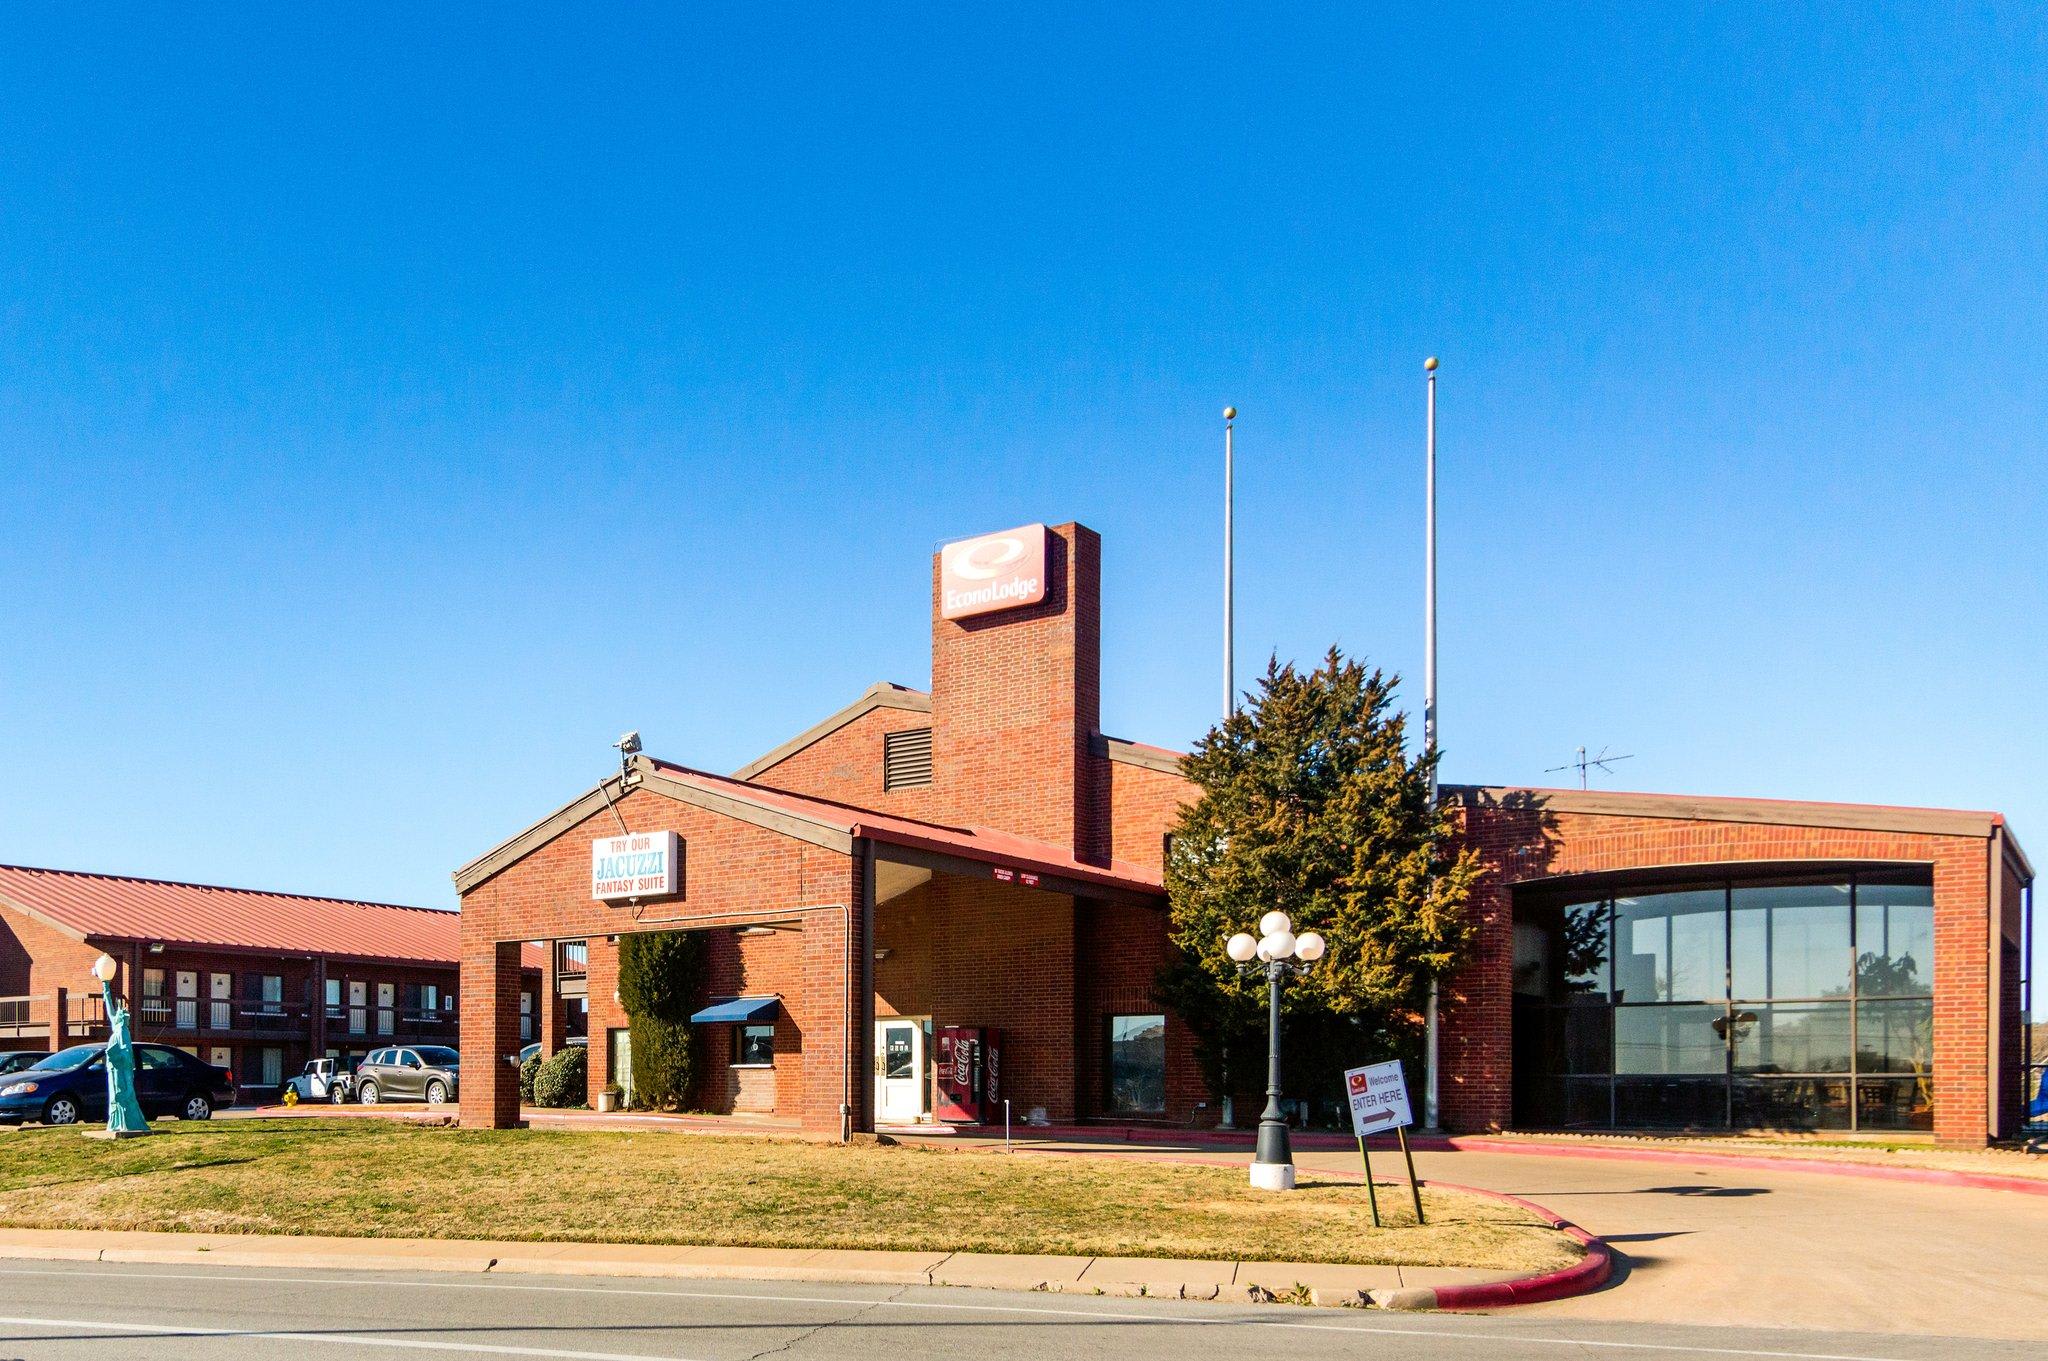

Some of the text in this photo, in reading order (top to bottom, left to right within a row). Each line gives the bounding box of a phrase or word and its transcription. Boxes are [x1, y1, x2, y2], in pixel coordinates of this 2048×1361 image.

[610, 837, 650, 853] TRY OUR
[597, 852, 664, 880] JACUZZI
[596, 876, 665, 894] FANTASY SUITE
[1368, 1074, 1399, 1086] Welcome
[1353, 1095, 1378, 1111] ENTER
[1378, 1089, 1403, 1104] HERE
